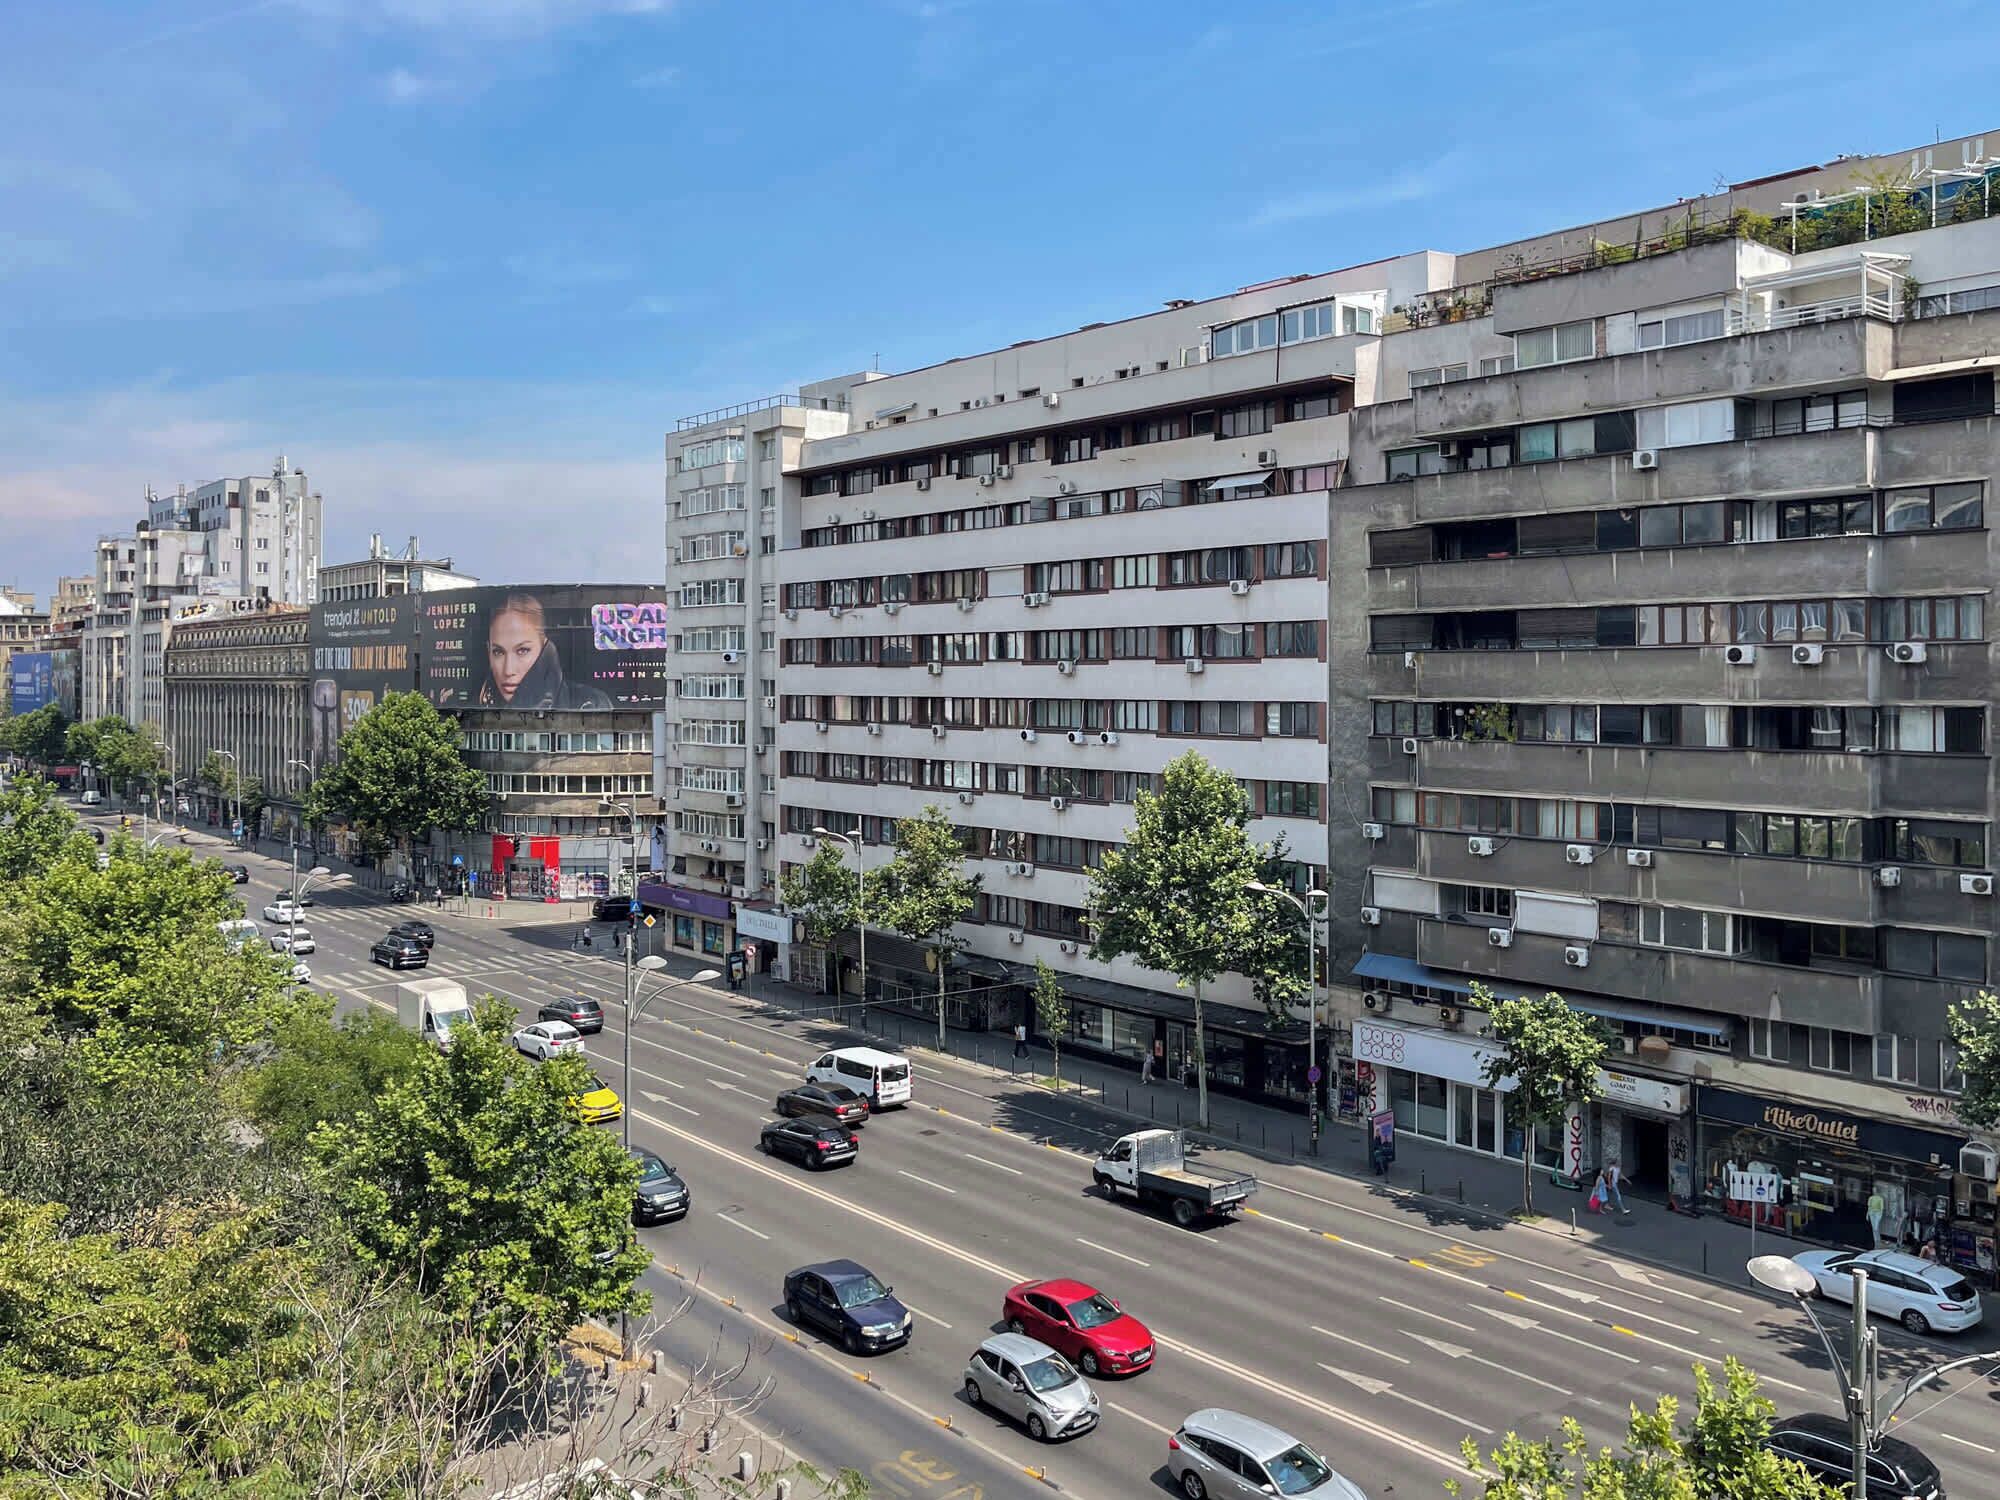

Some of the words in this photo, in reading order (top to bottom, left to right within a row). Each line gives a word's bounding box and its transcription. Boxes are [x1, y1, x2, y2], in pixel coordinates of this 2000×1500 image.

[427, 603, 477, 616] JENNIFER
[324, 608, 352, 629] trendyol
[361, 607, 397, 625] UNTOLD
[434, 618, 465, 630] LOPEZ
[435, 641, 445, 650] 27
[445, 640, 463, 650] IULIE
